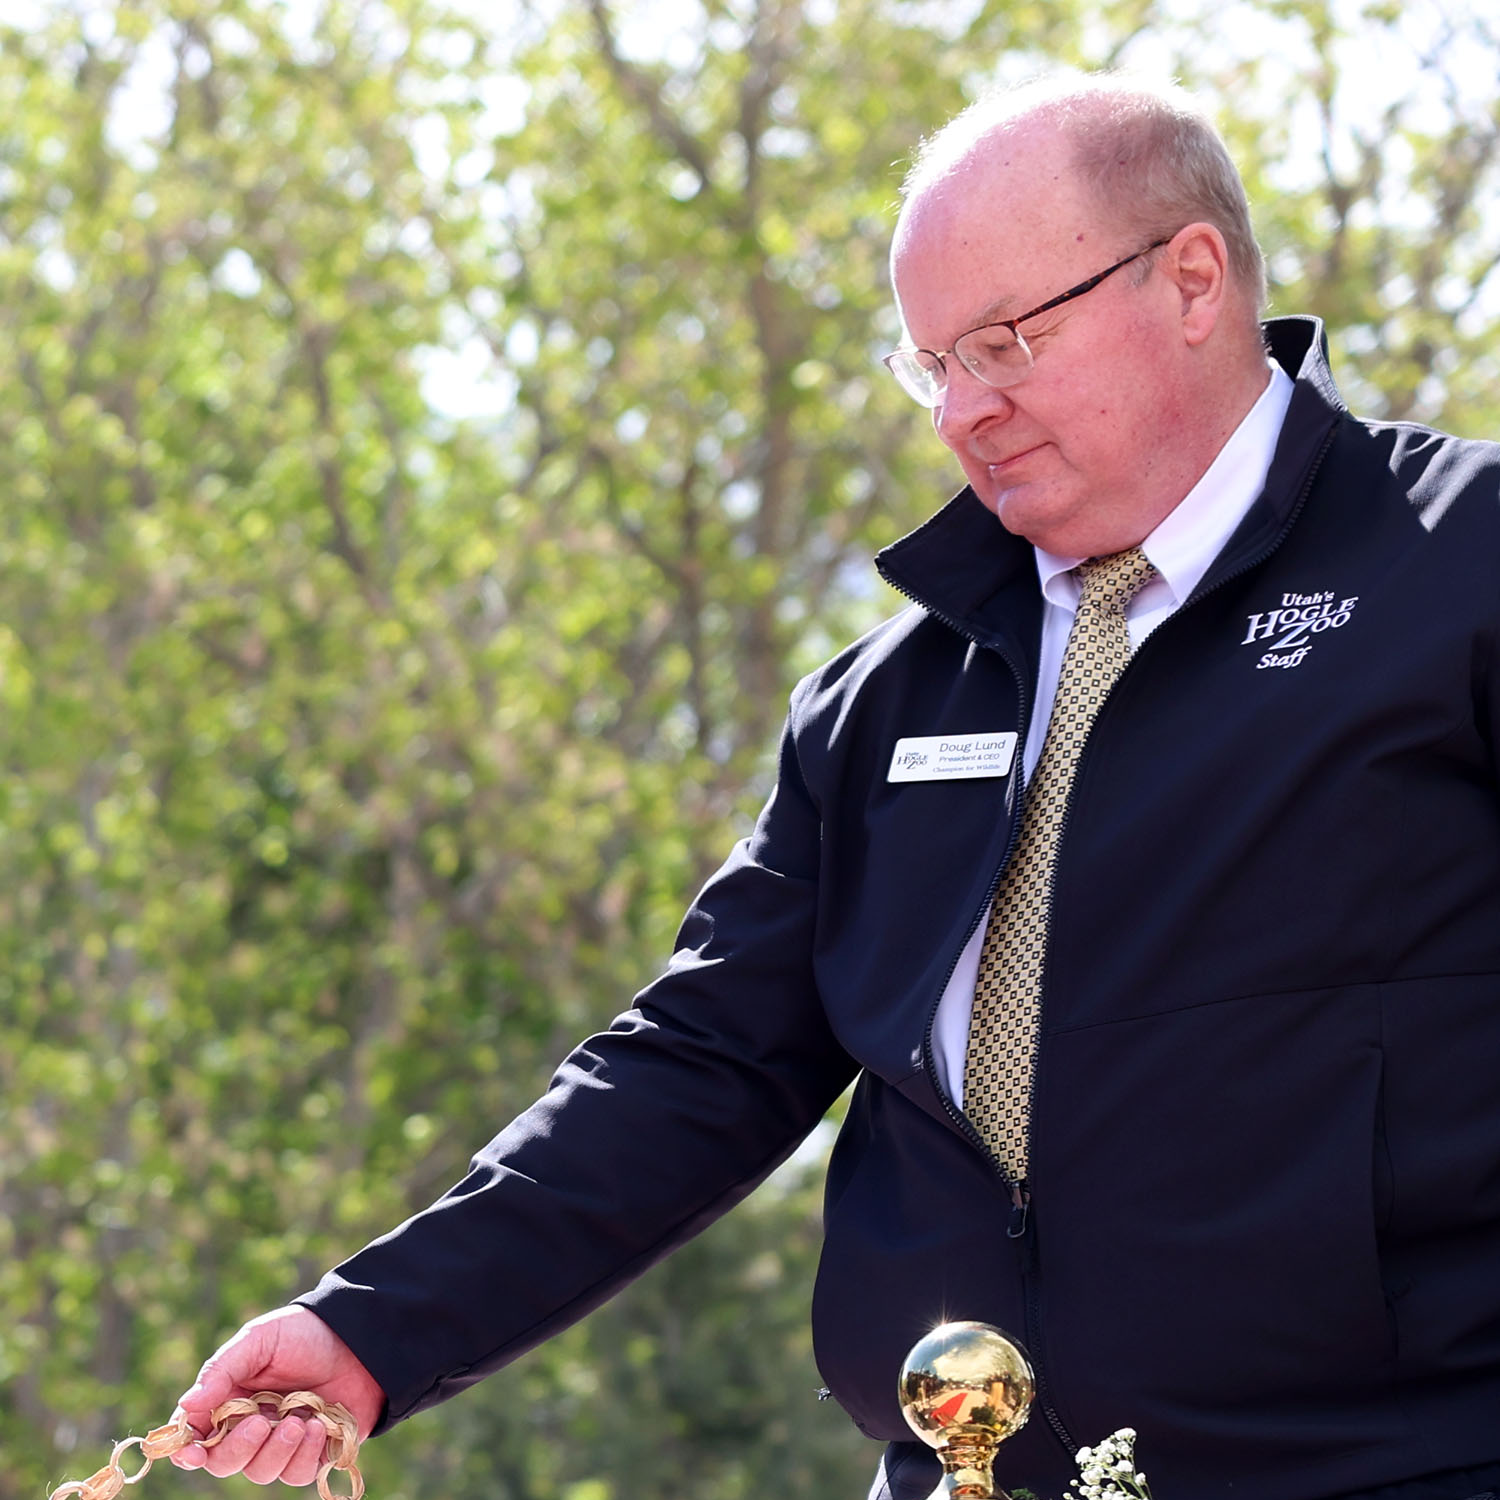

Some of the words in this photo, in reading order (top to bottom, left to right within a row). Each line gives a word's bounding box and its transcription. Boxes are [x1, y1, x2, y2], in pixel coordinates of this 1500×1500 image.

[1281, 591, 1335, 607] Utah's
[1256, 645, 1312, 669] Staff
[939, 742, 971, 754] Doug
[975, 739, 1006, 751] Lund
